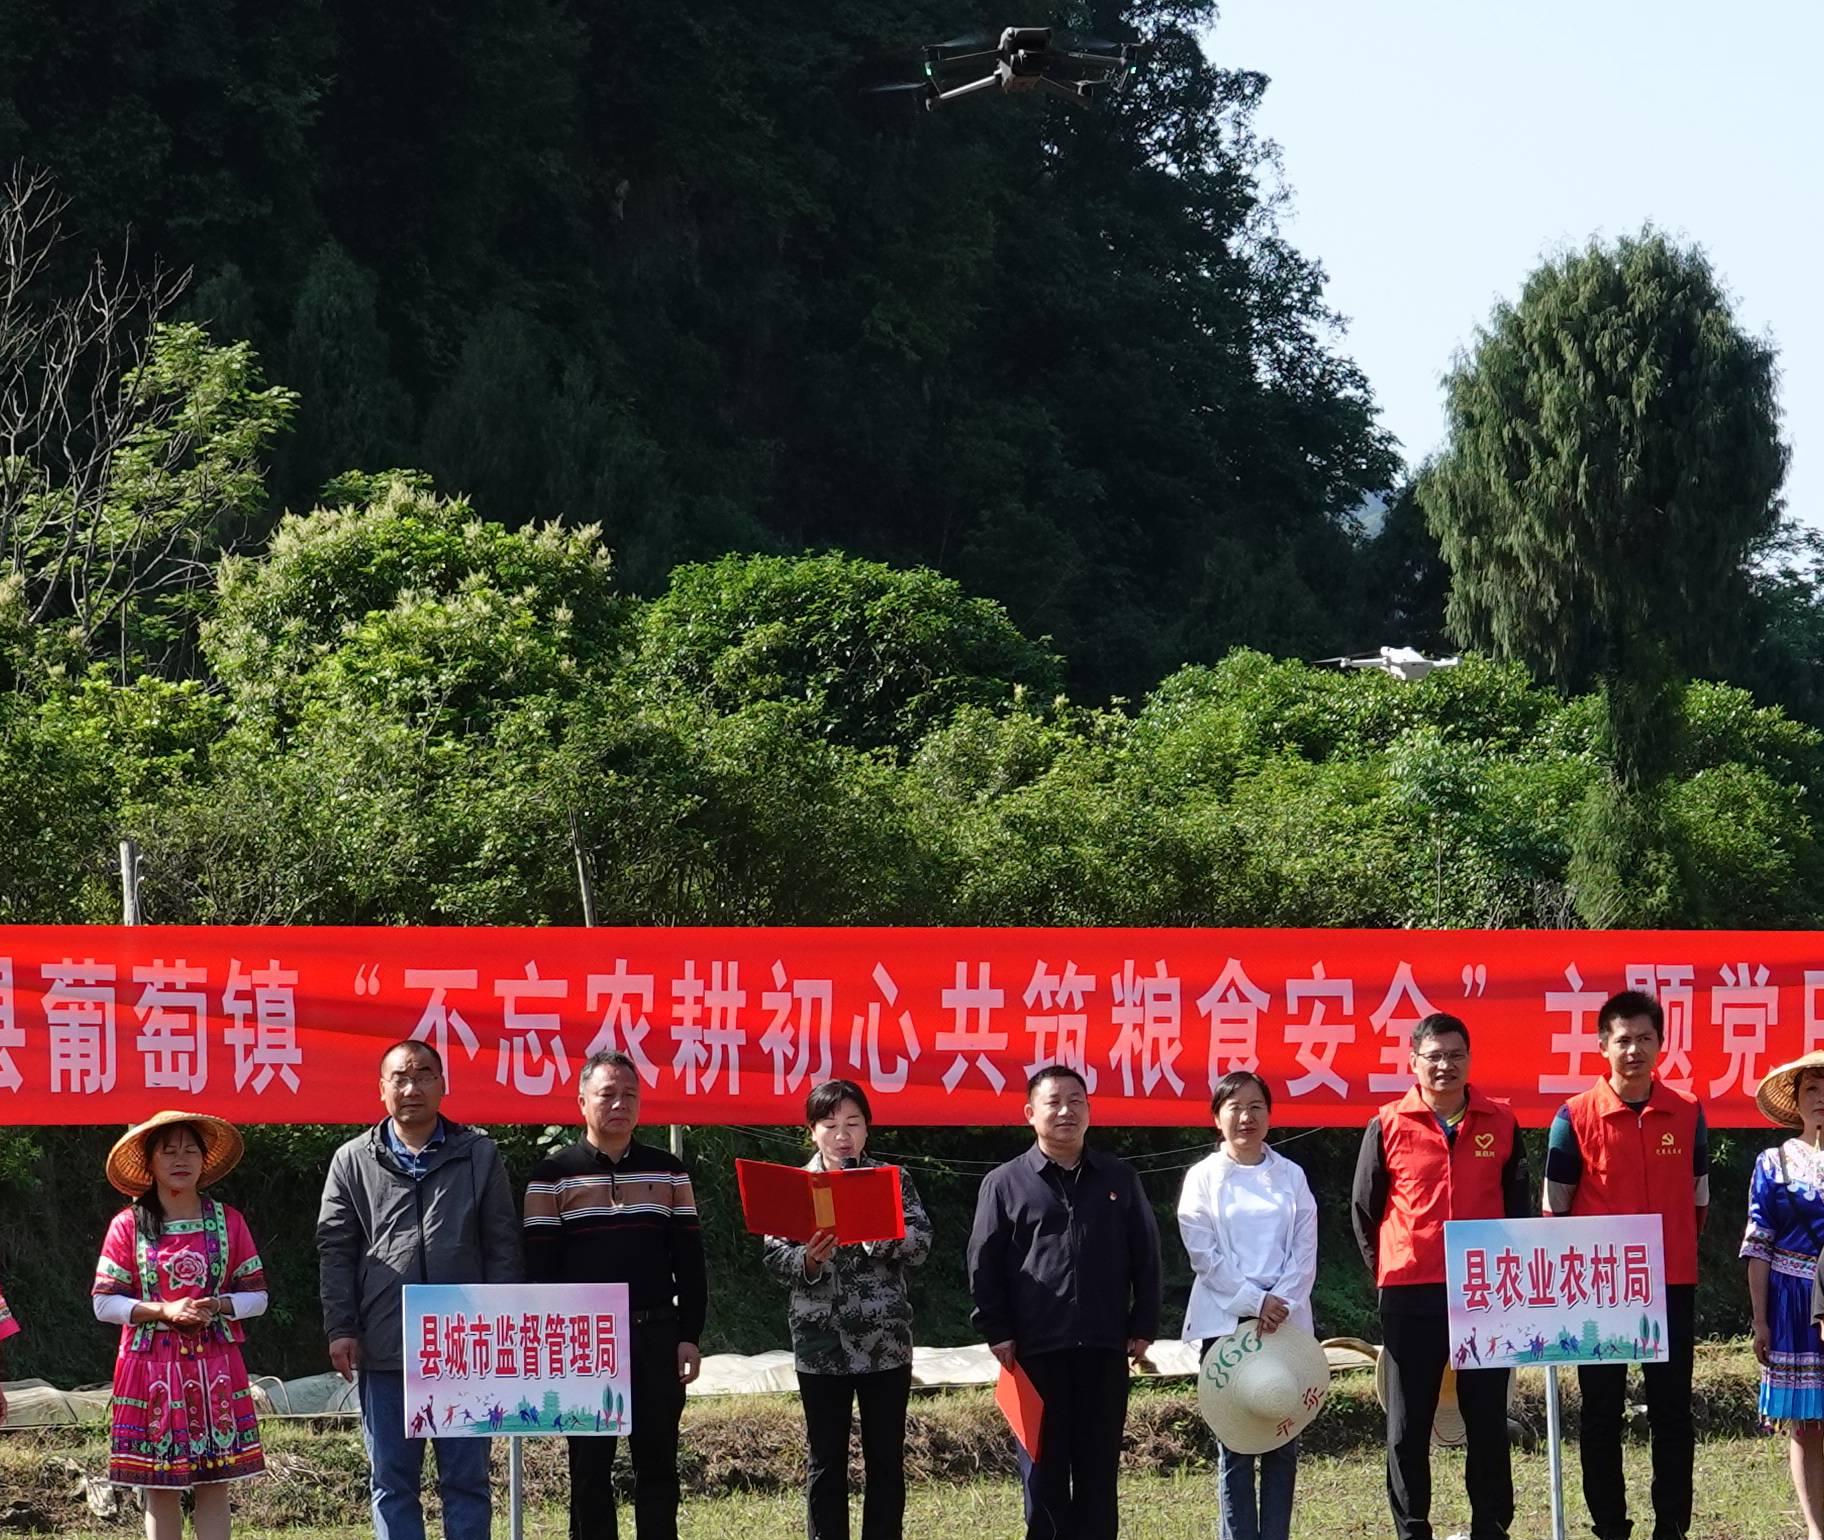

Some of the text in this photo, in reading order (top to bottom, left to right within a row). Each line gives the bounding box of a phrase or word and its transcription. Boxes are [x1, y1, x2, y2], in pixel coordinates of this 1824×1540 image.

[1463, 1244, 1653, 1311] 县农业农村局
[418, 1312, 618, 1379] 县城市监督管理局
